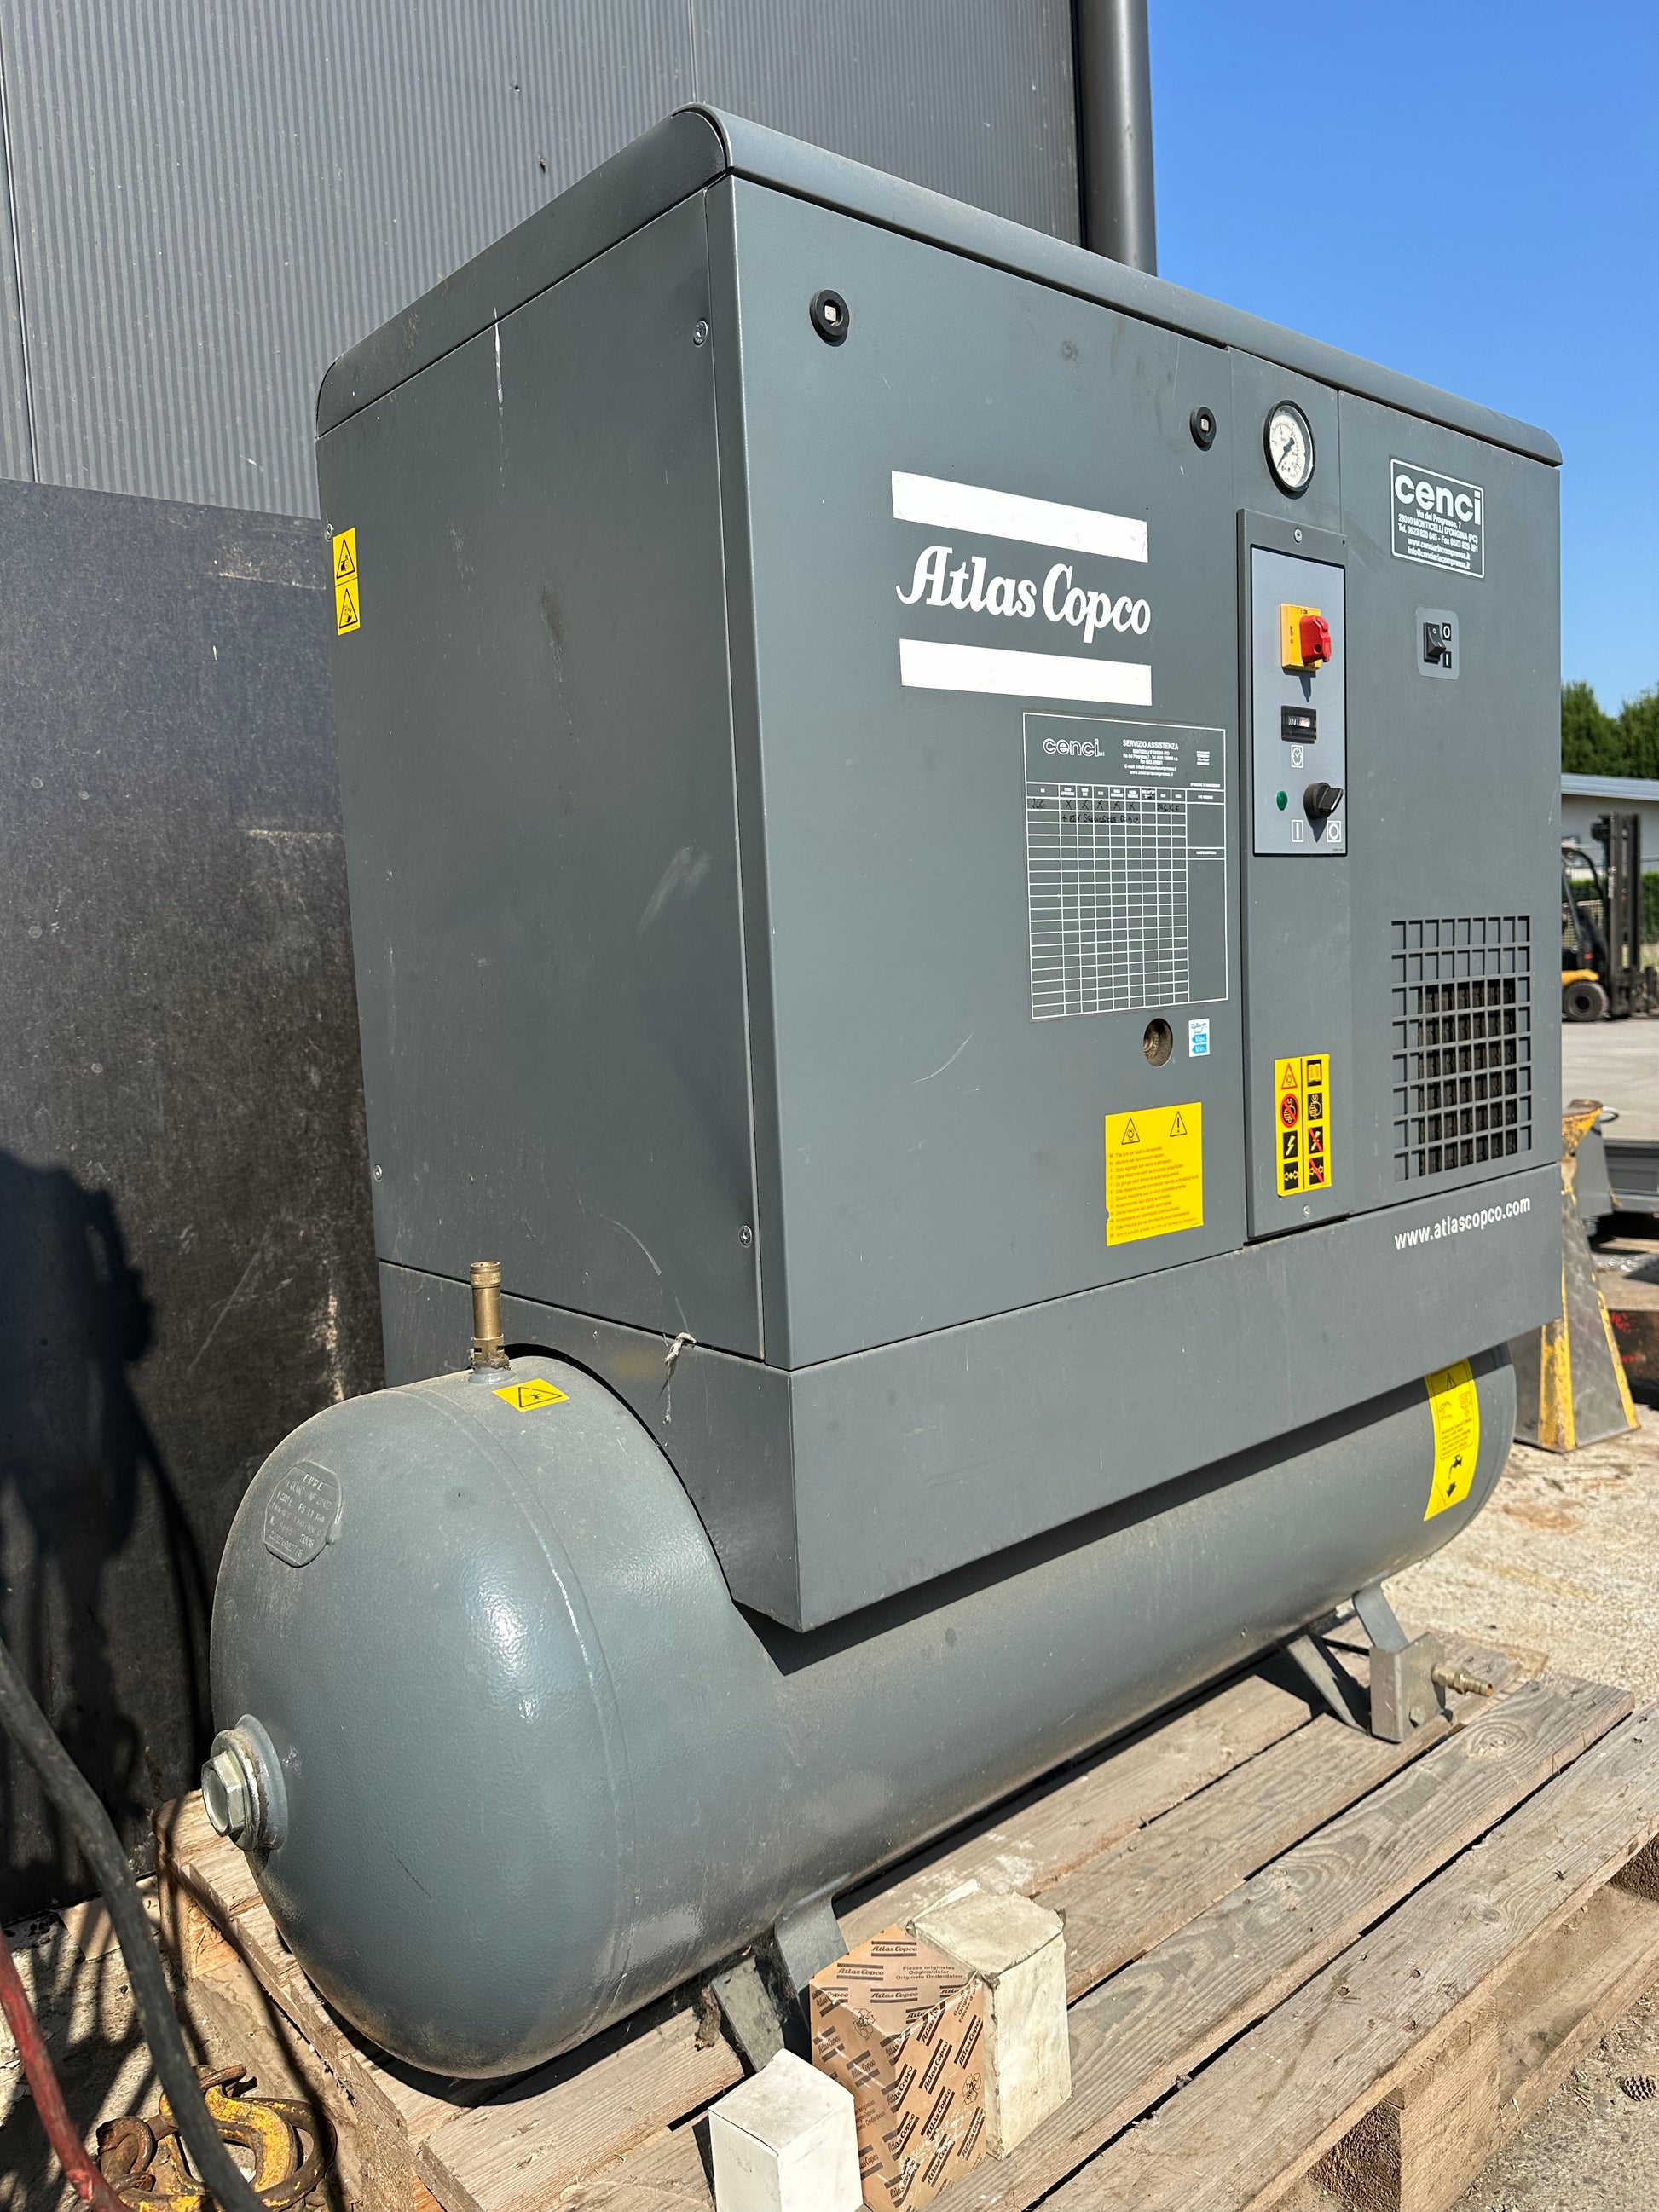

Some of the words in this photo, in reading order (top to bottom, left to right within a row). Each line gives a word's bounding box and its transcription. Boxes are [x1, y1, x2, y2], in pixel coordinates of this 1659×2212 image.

[1395, 474, 1481, 526] cenci
[1413, 517, 1443, 534] MONTICELLI
[896, 545, 1038, 618] Atlas
[1043, 563, 1151, 644] Copco
[1043, 738, 1099, 757] cenci
[1123, 739, 1147, 748] SERVIZIO
[1147, 741, 1179, 750] ASSISTENZA
[1394, 1197, 1531, 1250] www.atlascopco.com
[959, 2041, 971, 2065] Atlas
[969, 2017, 981, 2042] Copco
[861, 2059, 876, 2072] Copco
[924, 2065, 939, 2091] Atlas
[936, 2041, 948, 2065] Copco
[887, 2091, 901, 2105] Atlas
[899, 2066, 913, 2093] Copco
[926, 2113, 939, 2139] Atlas
[938, 2088, 951, 2114] Copco
[888, 2138, 902, 2152] Atlas
[901, 2114, 915, 2139] Copco
[962, 2134, 974, 2158] Atlas
[927, 2160, 939, 2185] Atlas
